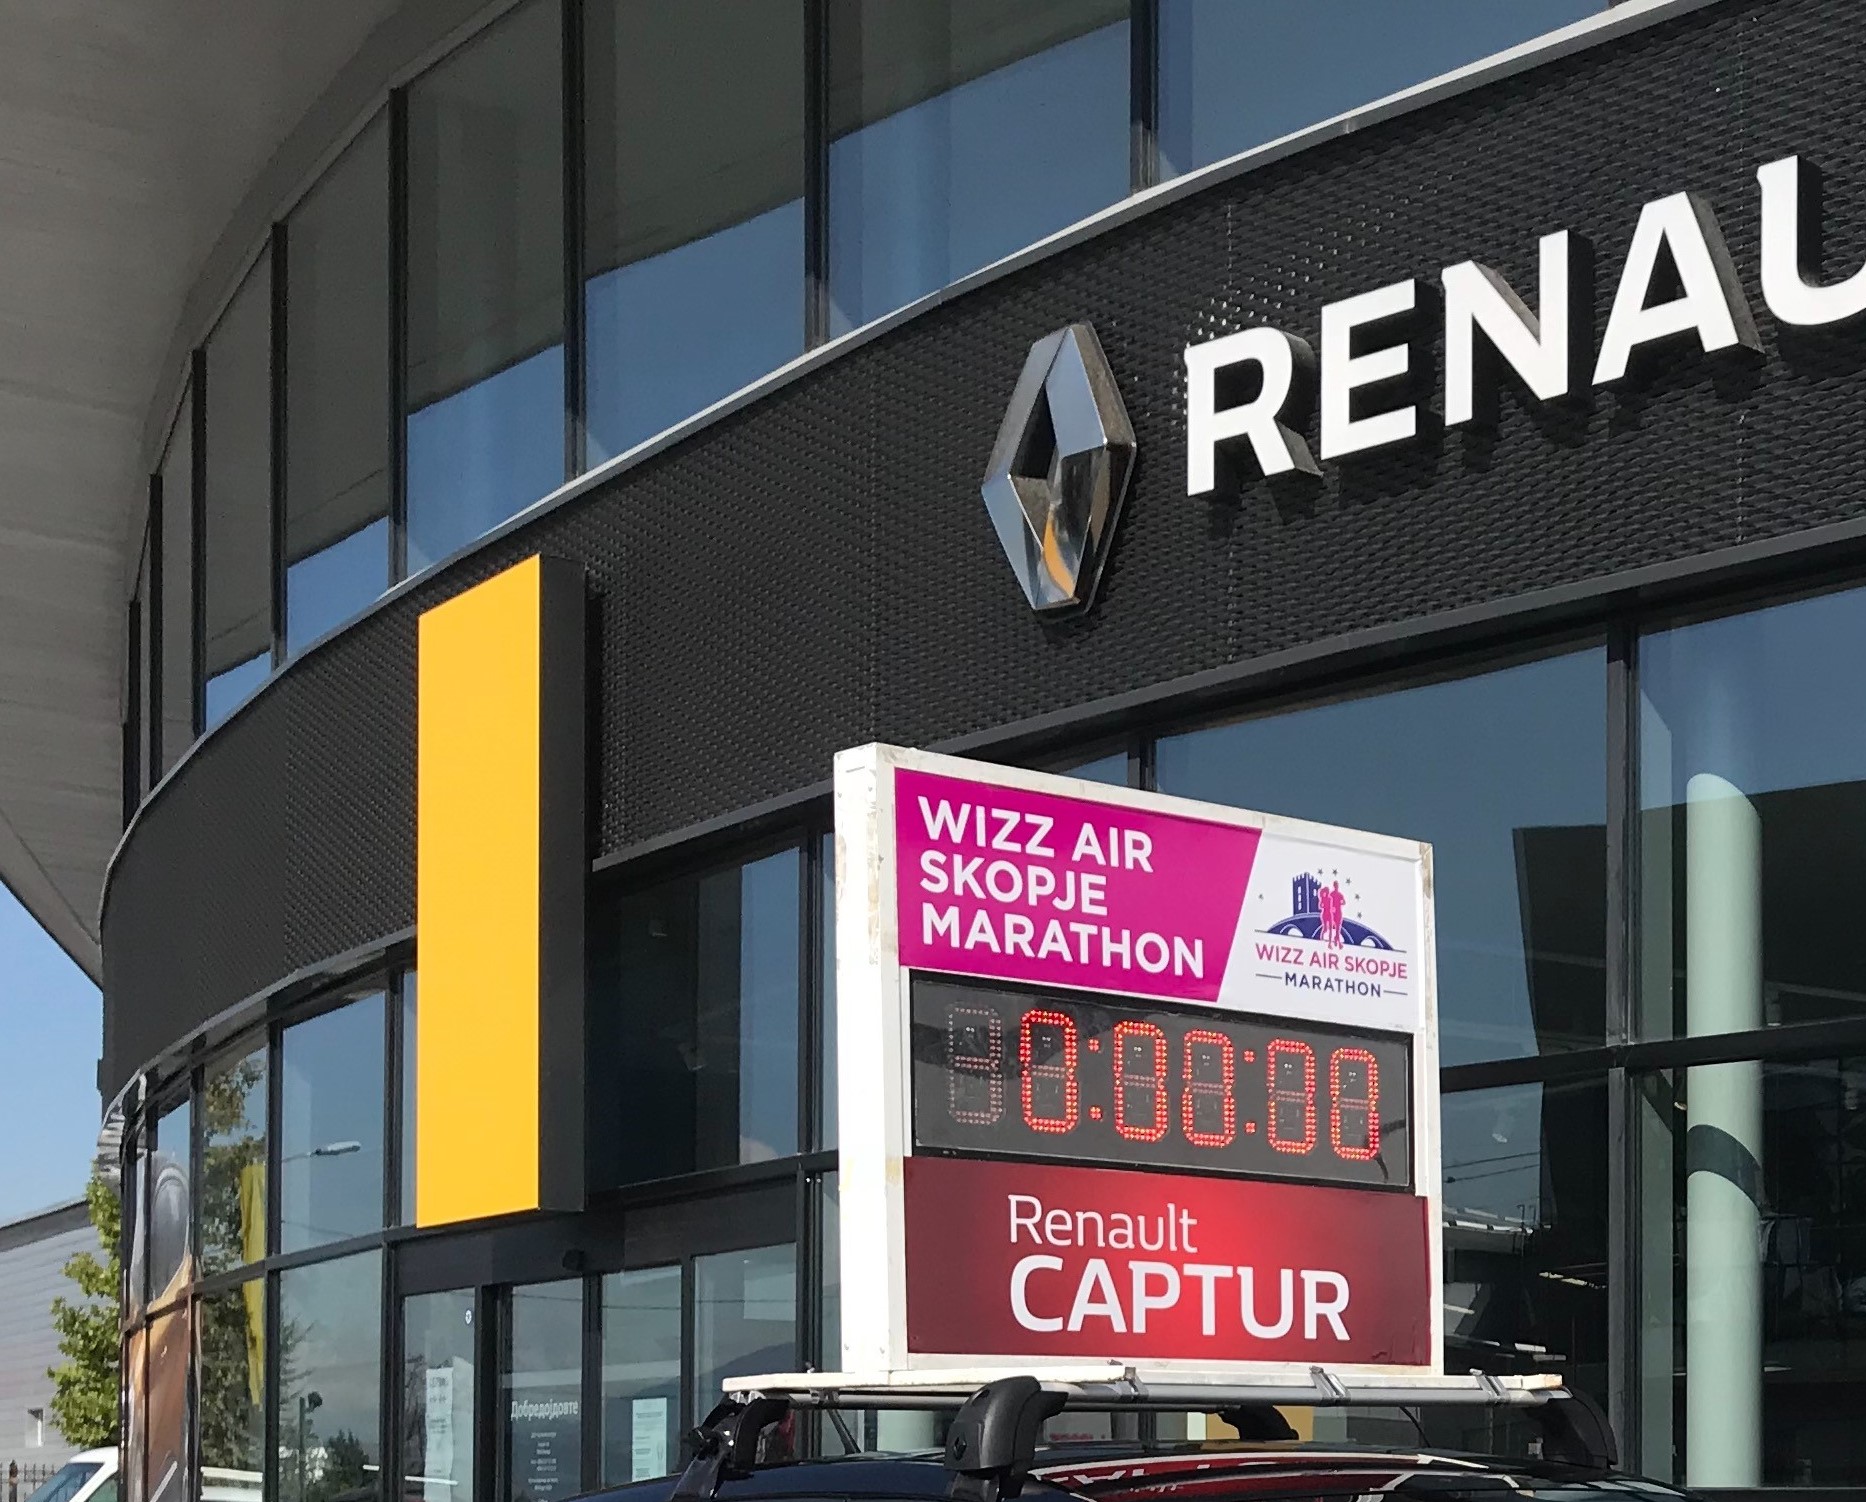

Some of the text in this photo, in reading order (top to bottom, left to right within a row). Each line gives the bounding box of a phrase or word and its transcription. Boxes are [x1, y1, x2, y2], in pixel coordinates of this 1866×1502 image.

[917, 796, 1154, 872] WIZZ AIR
[919, 851, 1108, 916] SKOPJE
[922, 902, 1204, 978] MARATHON
[1255, 942, 1408, 980] WIZZ AIR SKOPJE
[1284, 974, 1381, 998] MARATHON
[1008, 1194, 1198, 1254] Renault
[1010, 1254, 1351, 1342] CAPTUR
